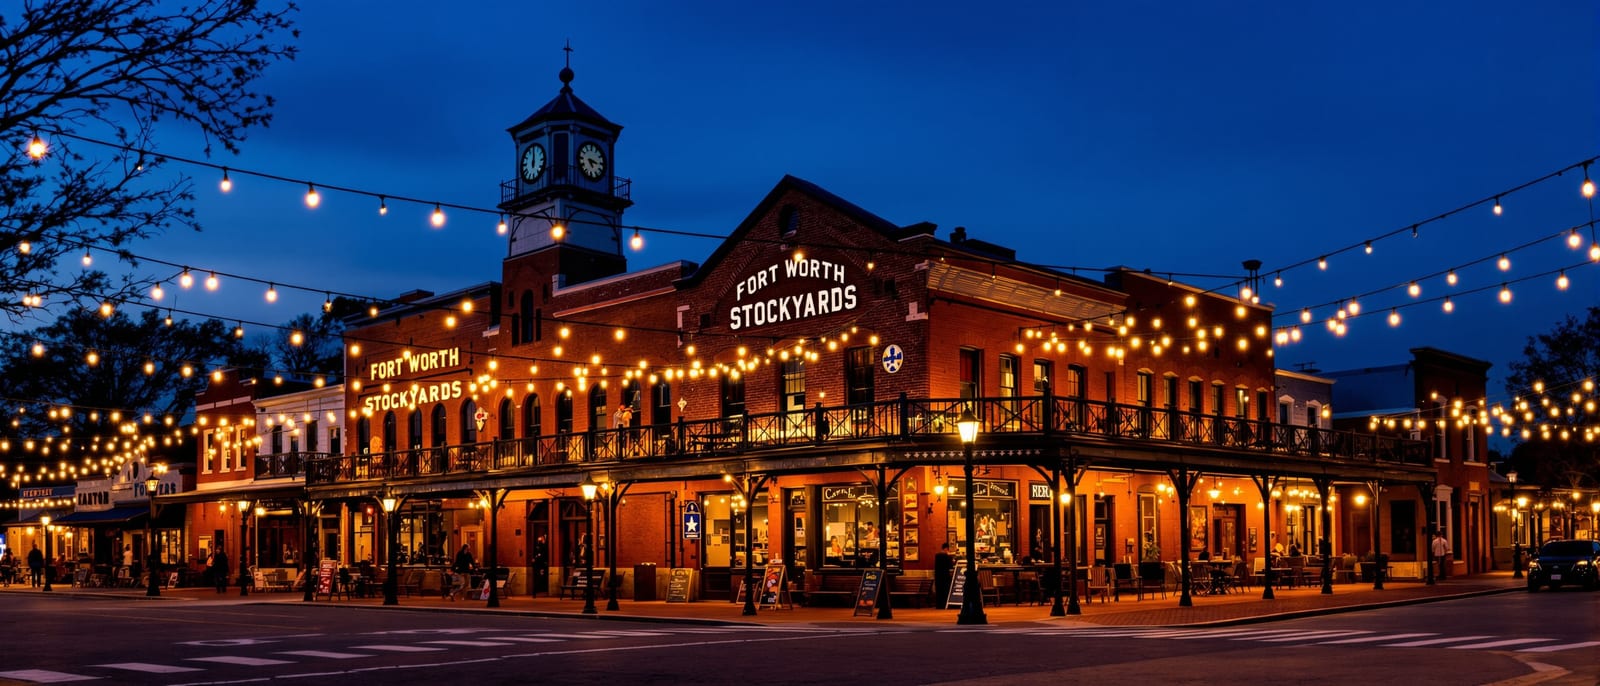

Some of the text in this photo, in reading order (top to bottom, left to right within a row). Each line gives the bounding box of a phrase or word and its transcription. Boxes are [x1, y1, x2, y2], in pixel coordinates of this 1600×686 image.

[737, 258, 845, 301] FORT WORTH
[730, 284, 857, 330] STOCKYARDS
[370, 347, 459, 380] FORT WORTH
[365, 381, 462, 411] STOCKYARDS
